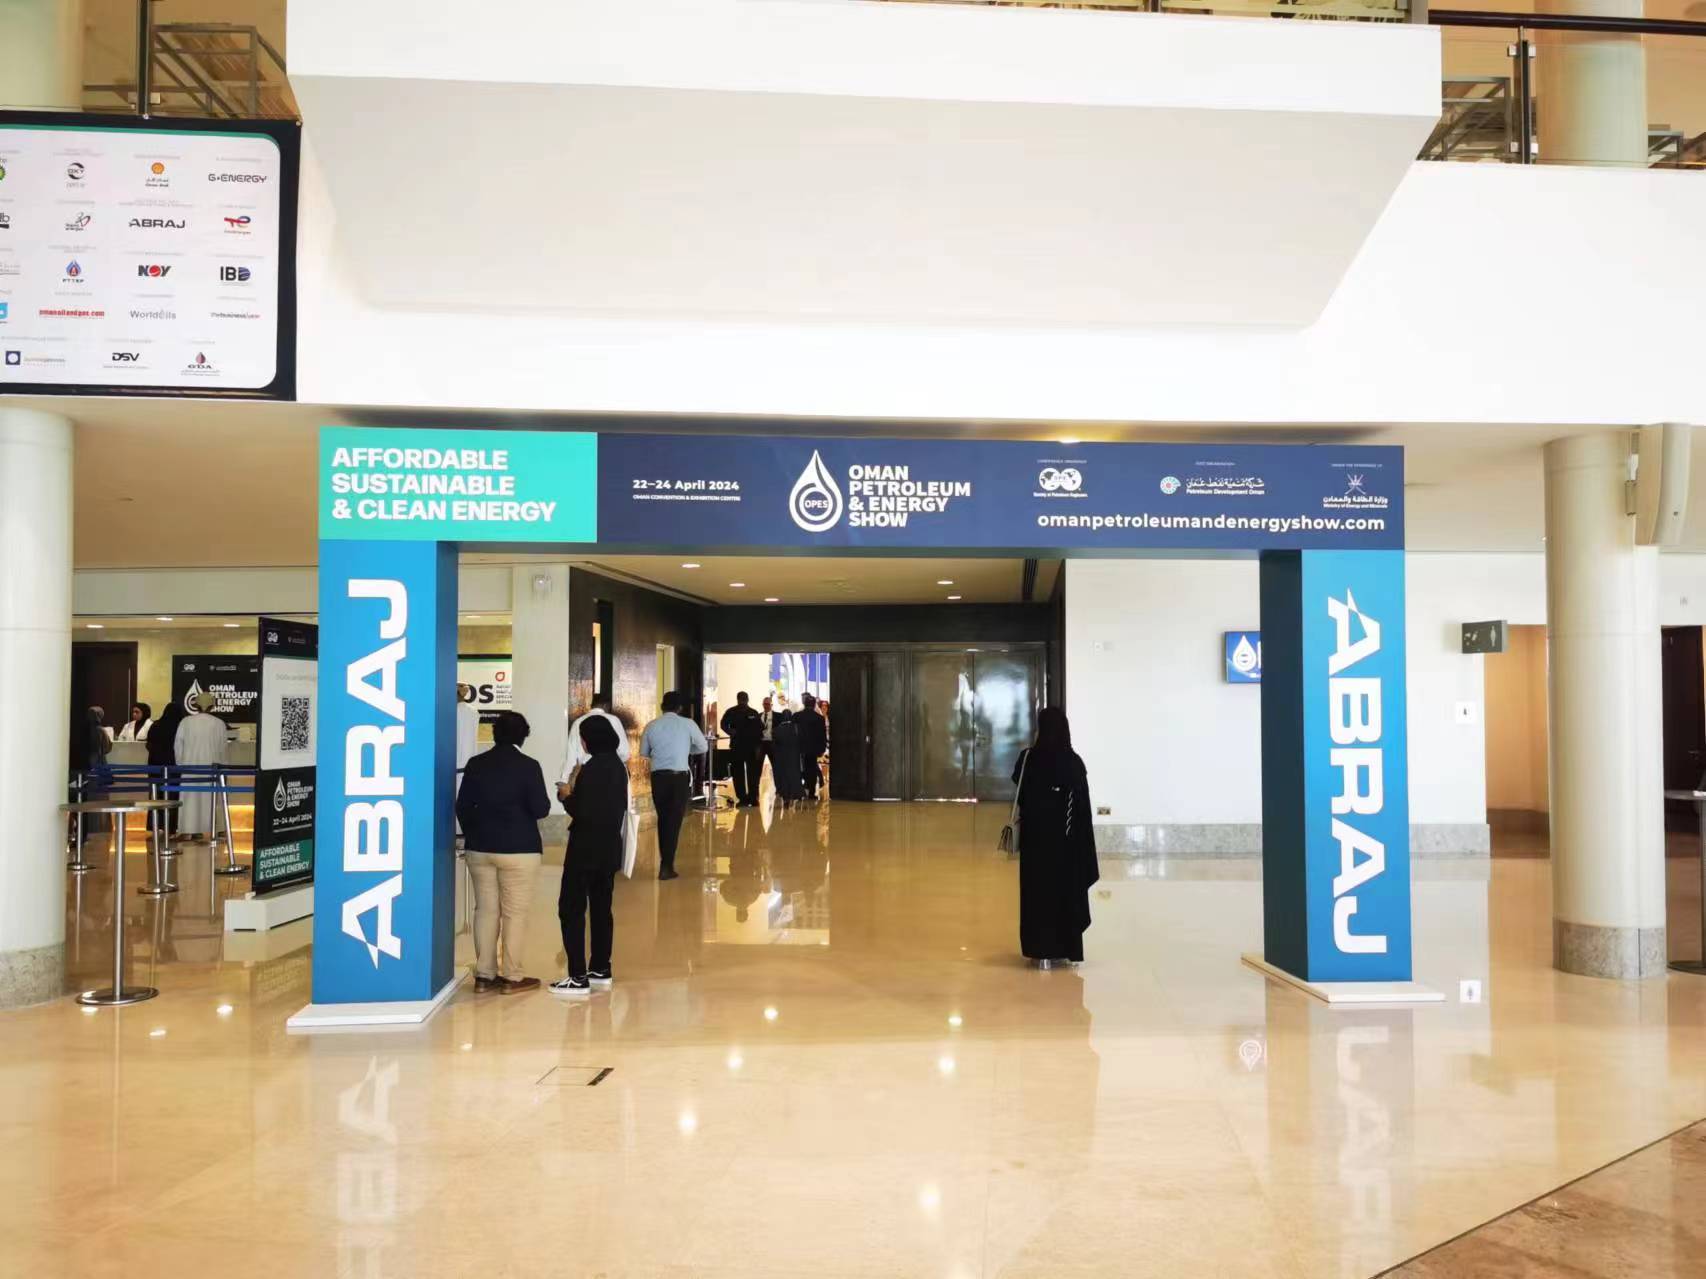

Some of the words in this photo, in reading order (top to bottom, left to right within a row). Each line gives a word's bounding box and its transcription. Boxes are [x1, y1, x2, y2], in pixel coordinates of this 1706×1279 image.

[129, 218, 186, 229] ABRAJ
[112, 352, 140, 362] DSV
[331, 447, 508, 470] AFFORDABLE
[848, 465, 909, 480] OMAN
[331, 473, 515, 496] SUSTAINABLE
[674, 480, 706, 491] April
[708, 481, 740, 491] 2024
[849, 481, 971, 497] PETROLEUM
[332, 498, 352, 519] &
[357, 499, 446, 520] CLEAN
[452, 501, 556, 522] ENERGY
[804, 500, 828, 509] OPES
[848, 496, 864, 511] &
[869, 497, 949, 512] ENERGY
[848, 512, 908, 527] SHOW
[1037, 513, 1385, 532] omanpetroleumandenergyshow.com
[217, 698, 252, 706] ENERGY
[341, 579, 408, 970] ABRAJ
[1328, 587, 1387, 954] ABRAJ
[260, 842, 300, 859] AFFORDABLE
[259, 853, 301, 870] SUSTAINABLE
[265, 865, 286, 879] CLEAN
[286, 860, 310, 874] ENERGY
